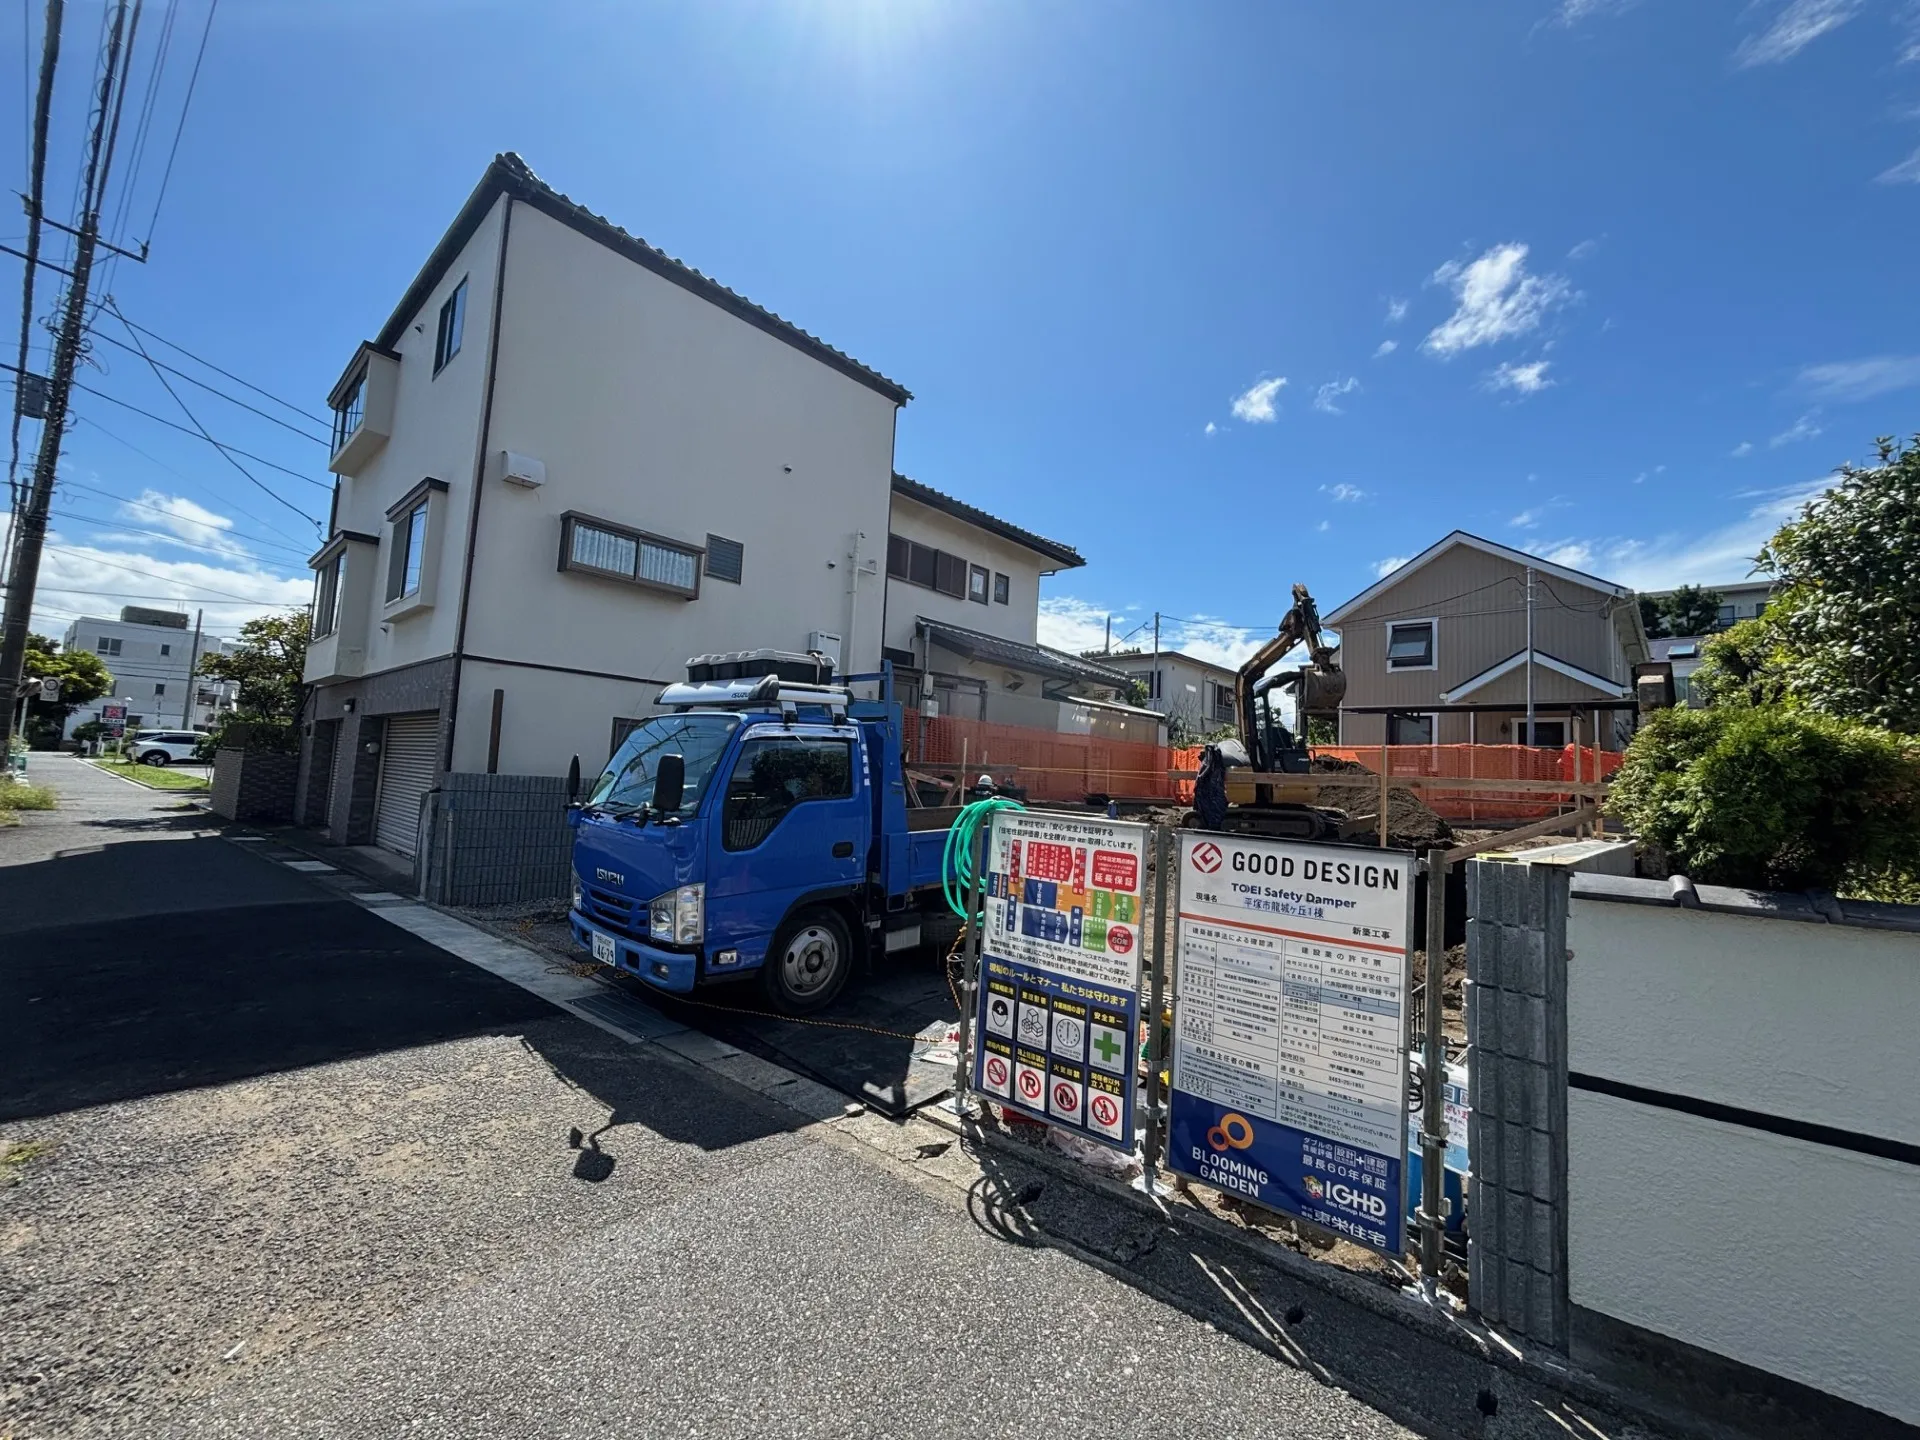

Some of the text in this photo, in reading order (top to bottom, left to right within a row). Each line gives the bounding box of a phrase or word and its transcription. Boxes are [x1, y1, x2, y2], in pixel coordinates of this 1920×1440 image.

[596, 867, 625, 886] ISUZU
[1232, 851, 1399, 891] GOOD DESIGN
[1195, 892, 1218, 903] 現場名
[1264, 887, 1303, 903] Safety
[1305, 892, 1357, 910] Damper
[1352, 926, 1391, 940] 新築工事
[1301, 946, 1382, 967] 建設業の許可票
[1061, 982, 1128, 1008] 私たちは守ります
[1091, 1079, 1121, 1095] 立入禁止
[1303, 1136, 1333, 1151] ダブルの
[1335, 1146, 1355, 1160] 設計
[1191, 1146, 1269, 1186] BLOOMING
[1302, 1153, 1386, 1191] 最長60年保証
[1200, 1165, 1260, 1198] GARDEN
[1325, 1180, 1386, 1217] IGHD
[1338, 1203, 1358, 1216] Group
[1358, 1209, 1386, 1226] Holdings
[1314, 1209, 1386, 1248] 東栄住宅
